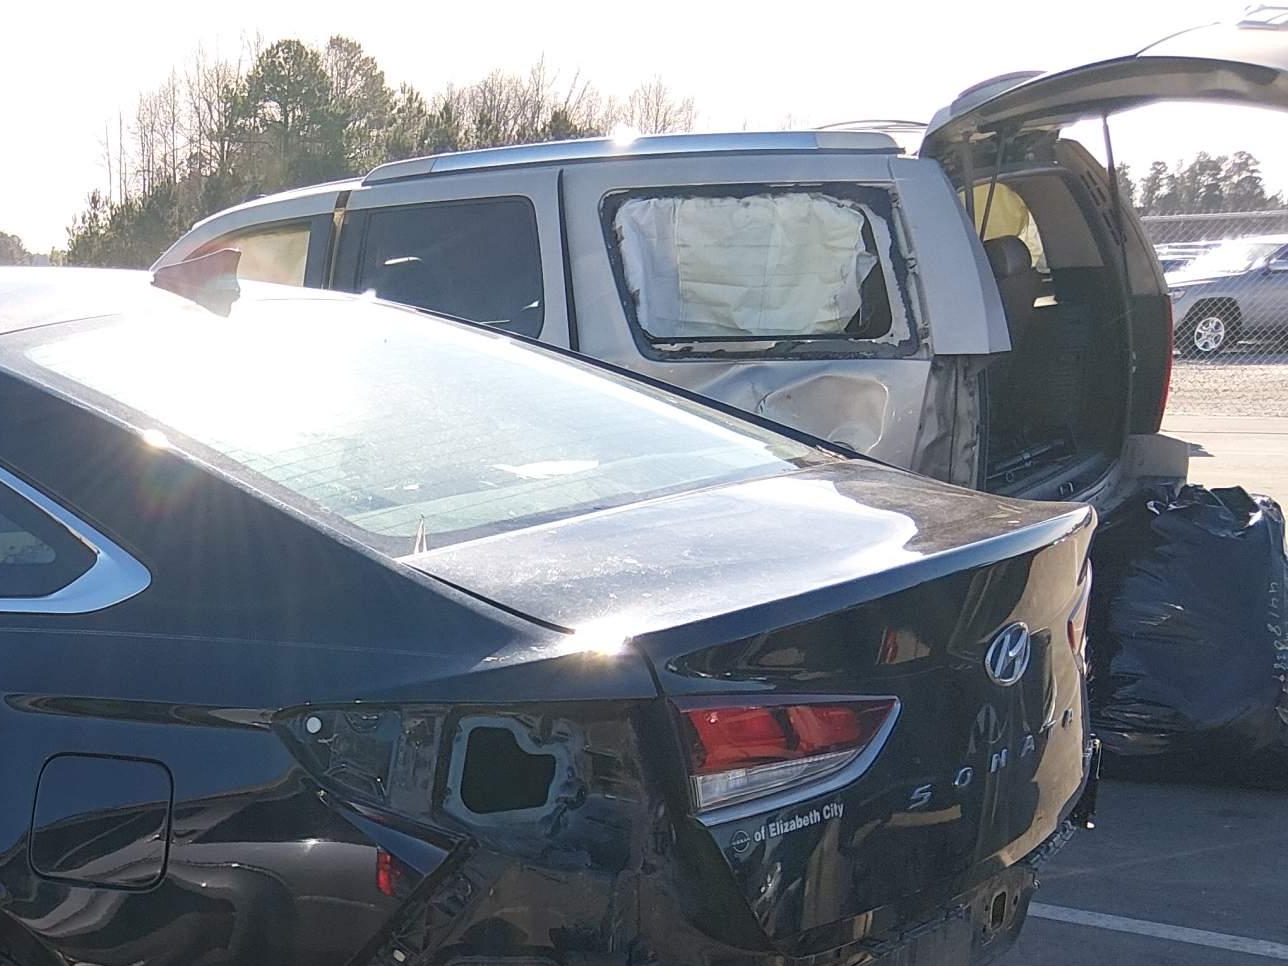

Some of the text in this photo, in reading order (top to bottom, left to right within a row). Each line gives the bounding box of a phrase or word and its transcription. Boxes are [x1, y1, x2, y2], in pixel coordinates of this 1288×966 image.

[753, 825, 766, 842] of
[768, 809, 821, 838] Elizabeth
[822, 802, 844, 820] City
